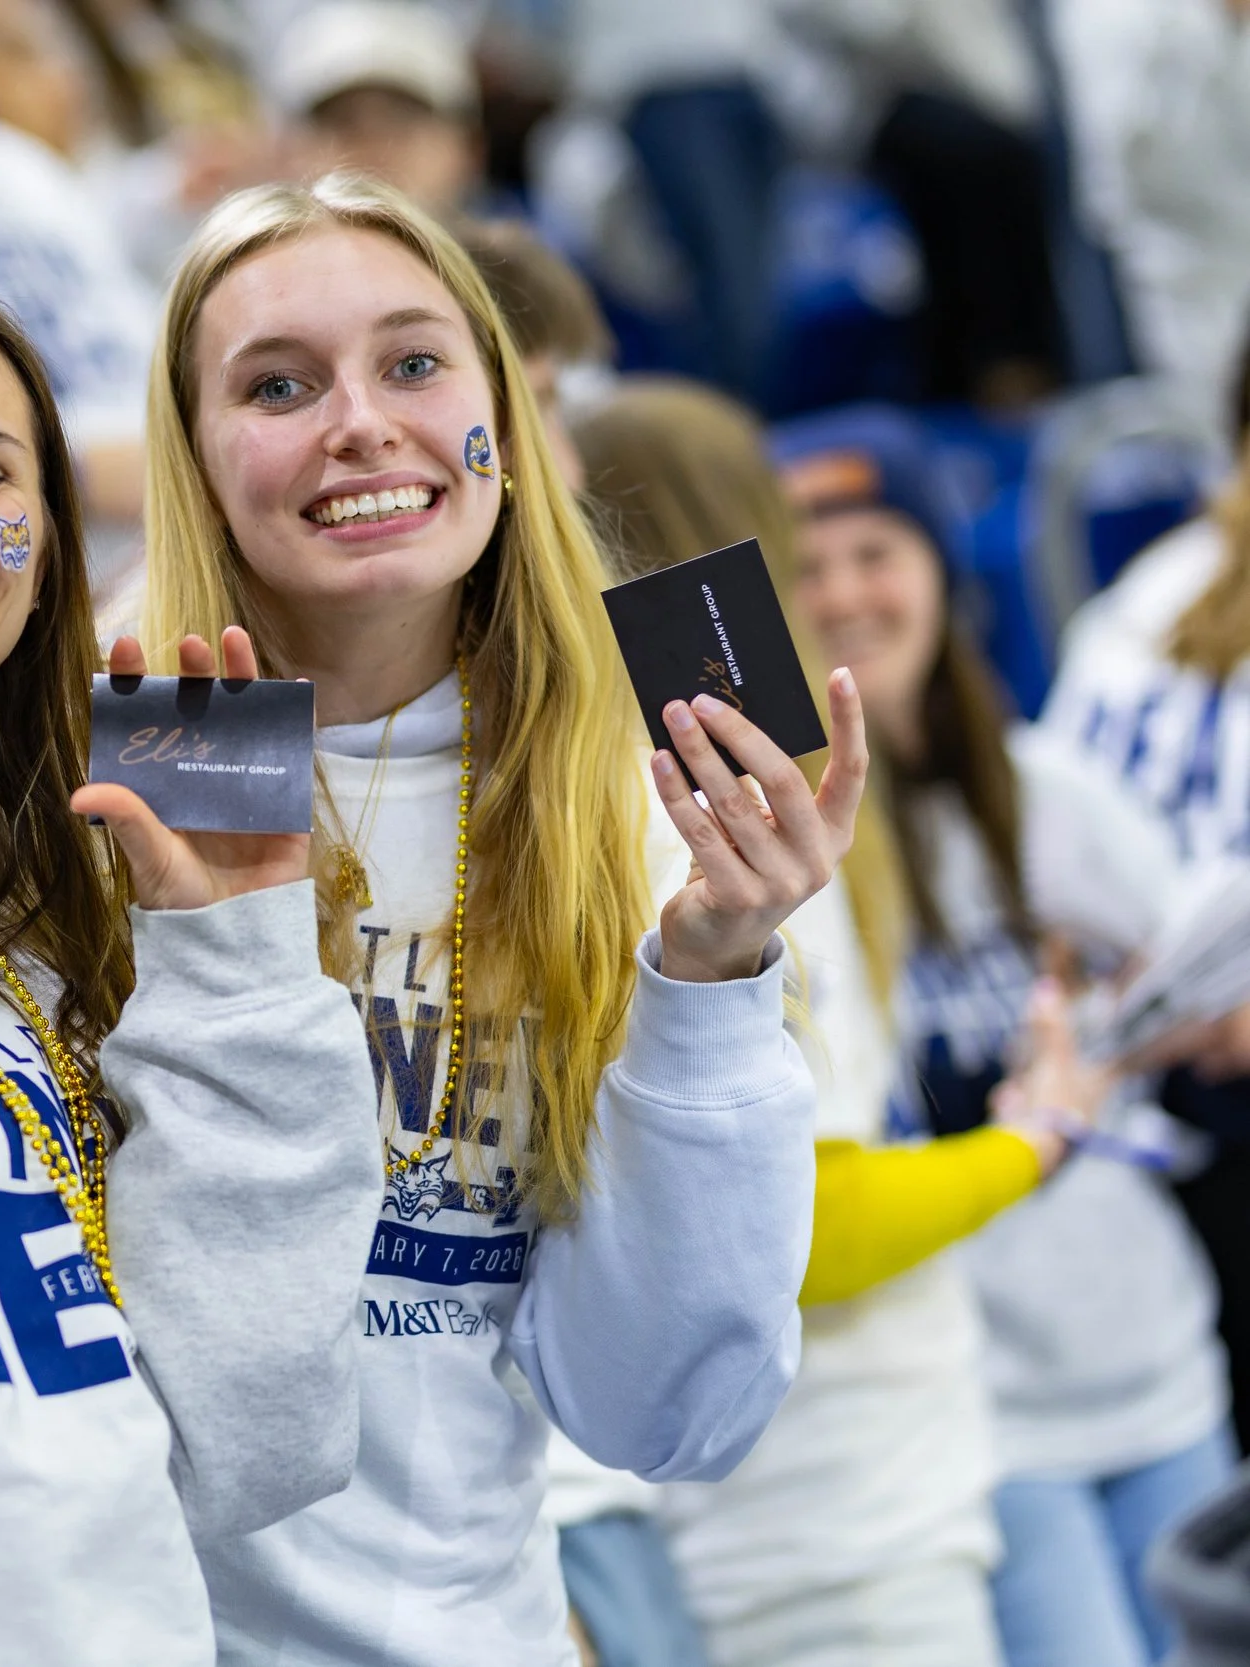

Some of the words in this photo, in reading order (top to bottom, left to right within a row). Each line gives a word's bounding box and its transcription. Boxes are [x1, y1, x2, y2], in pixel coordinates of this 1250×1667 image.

[701, 584, 720, 619] GROUP
[714, 622, 743, 686] RESTAURANT
[118, 727, 216, 765] Eli's
[177, 763, 245, 774] RESTAURANT
[249, 766, 286, 775] GROUP
[442, 1247, 459, 1275] 7,
[469, 1246, 523, 1273] 2026
[363, 1299, 443, 1337] M&T
